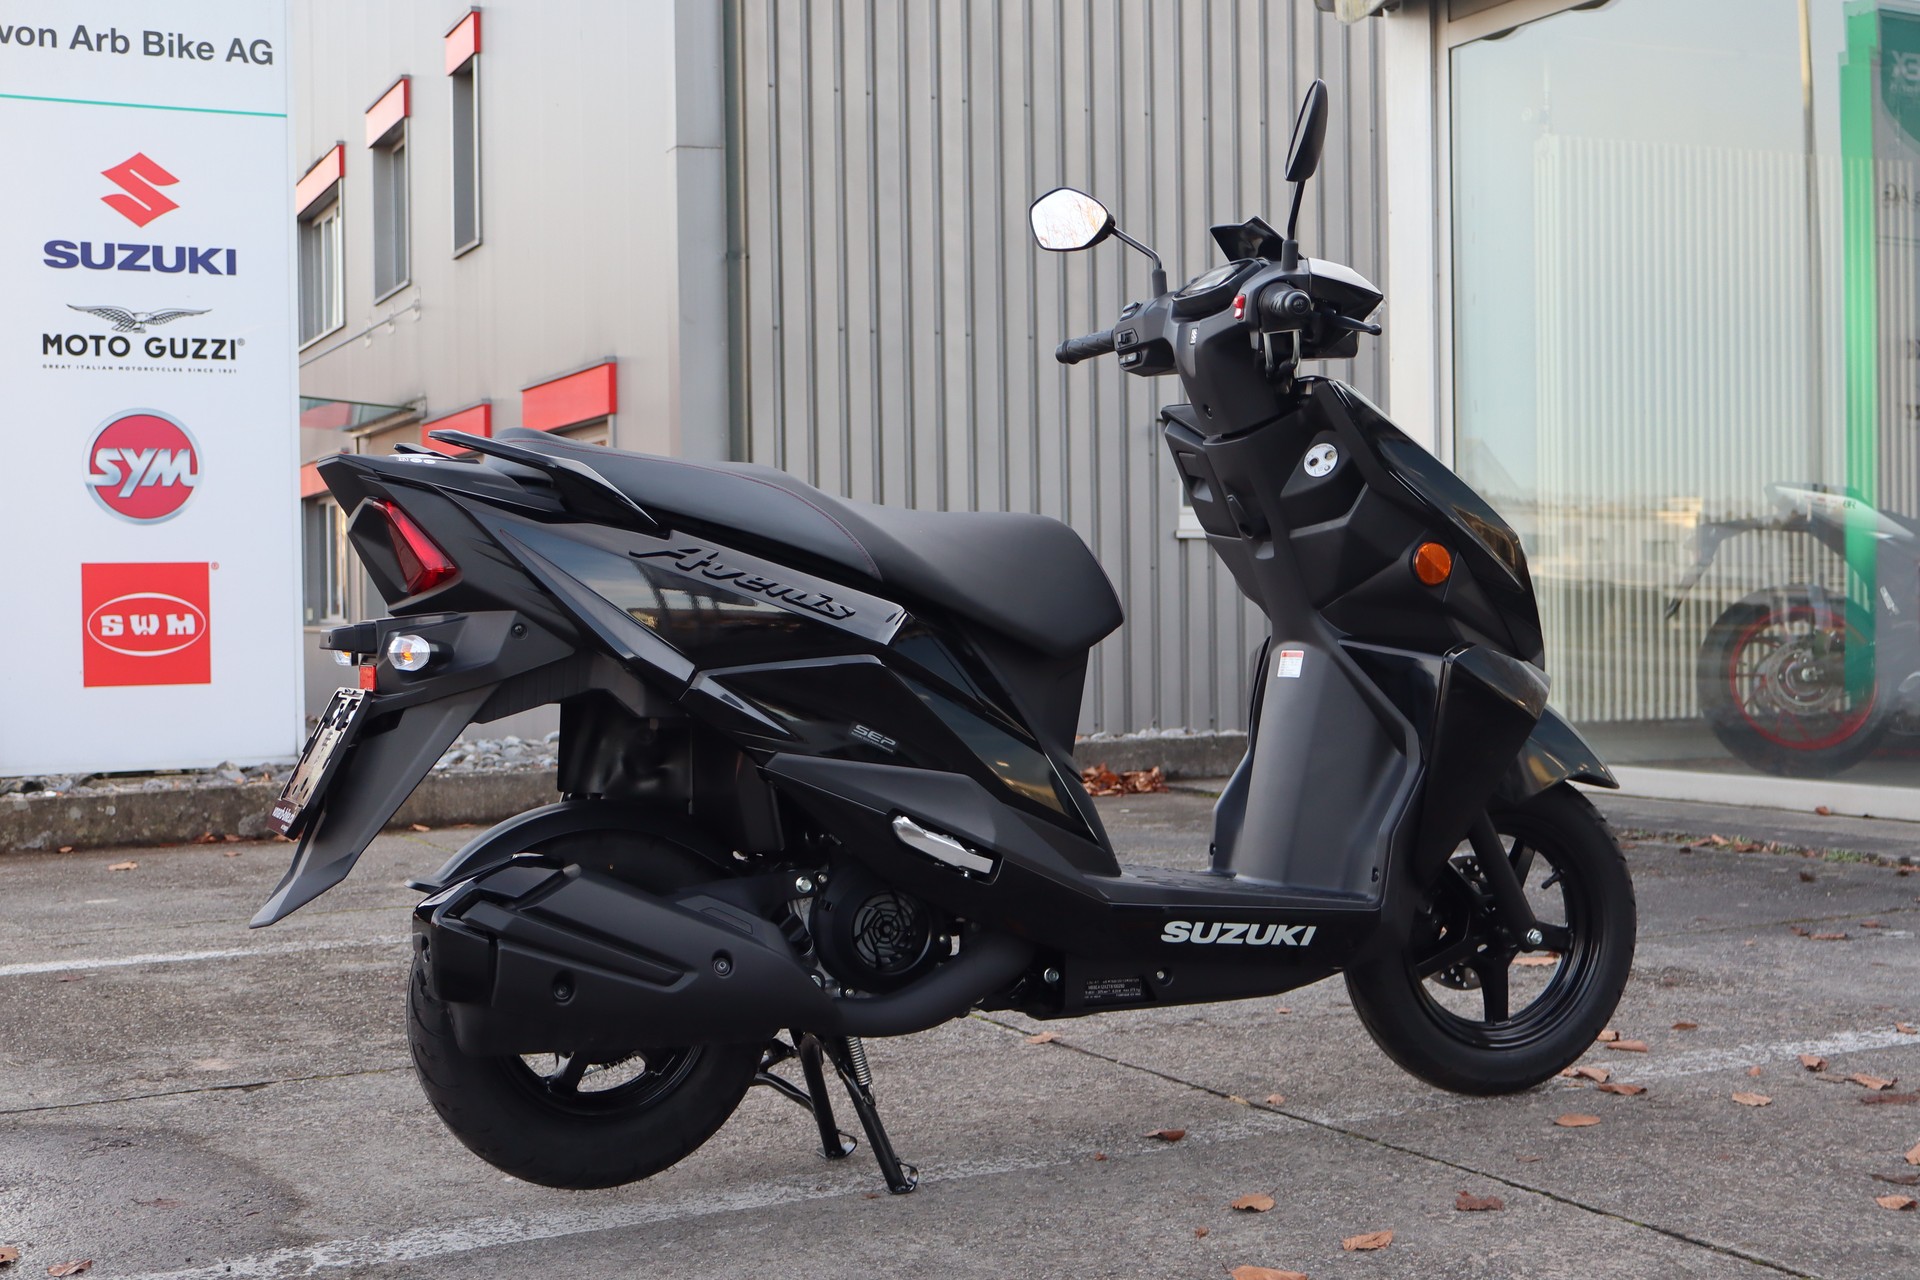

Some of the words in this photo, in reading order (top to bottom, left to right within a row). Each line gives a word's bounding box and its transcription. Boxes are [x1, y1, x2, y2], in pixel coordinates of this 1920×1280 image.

[0, 24, 57, 48] von
[69, 24, 130, 54] Arb
[142, 30, 215, 61] Bike
[225, 38, 273, 65] AG
[43, 240, 237, 276] SUZUKI
[42, 333, 131, 357] MOTO
[144, 337, 236, 360] GUZZI
[118, 365, 183, 373] MOTORCYCLES
[86, 447, 199, 498] SYM
[628, 548, 857, 621] Avenis
[853, 724, 896, 746] SEP
[1160, 920, 1317, 947] SUZUKI
